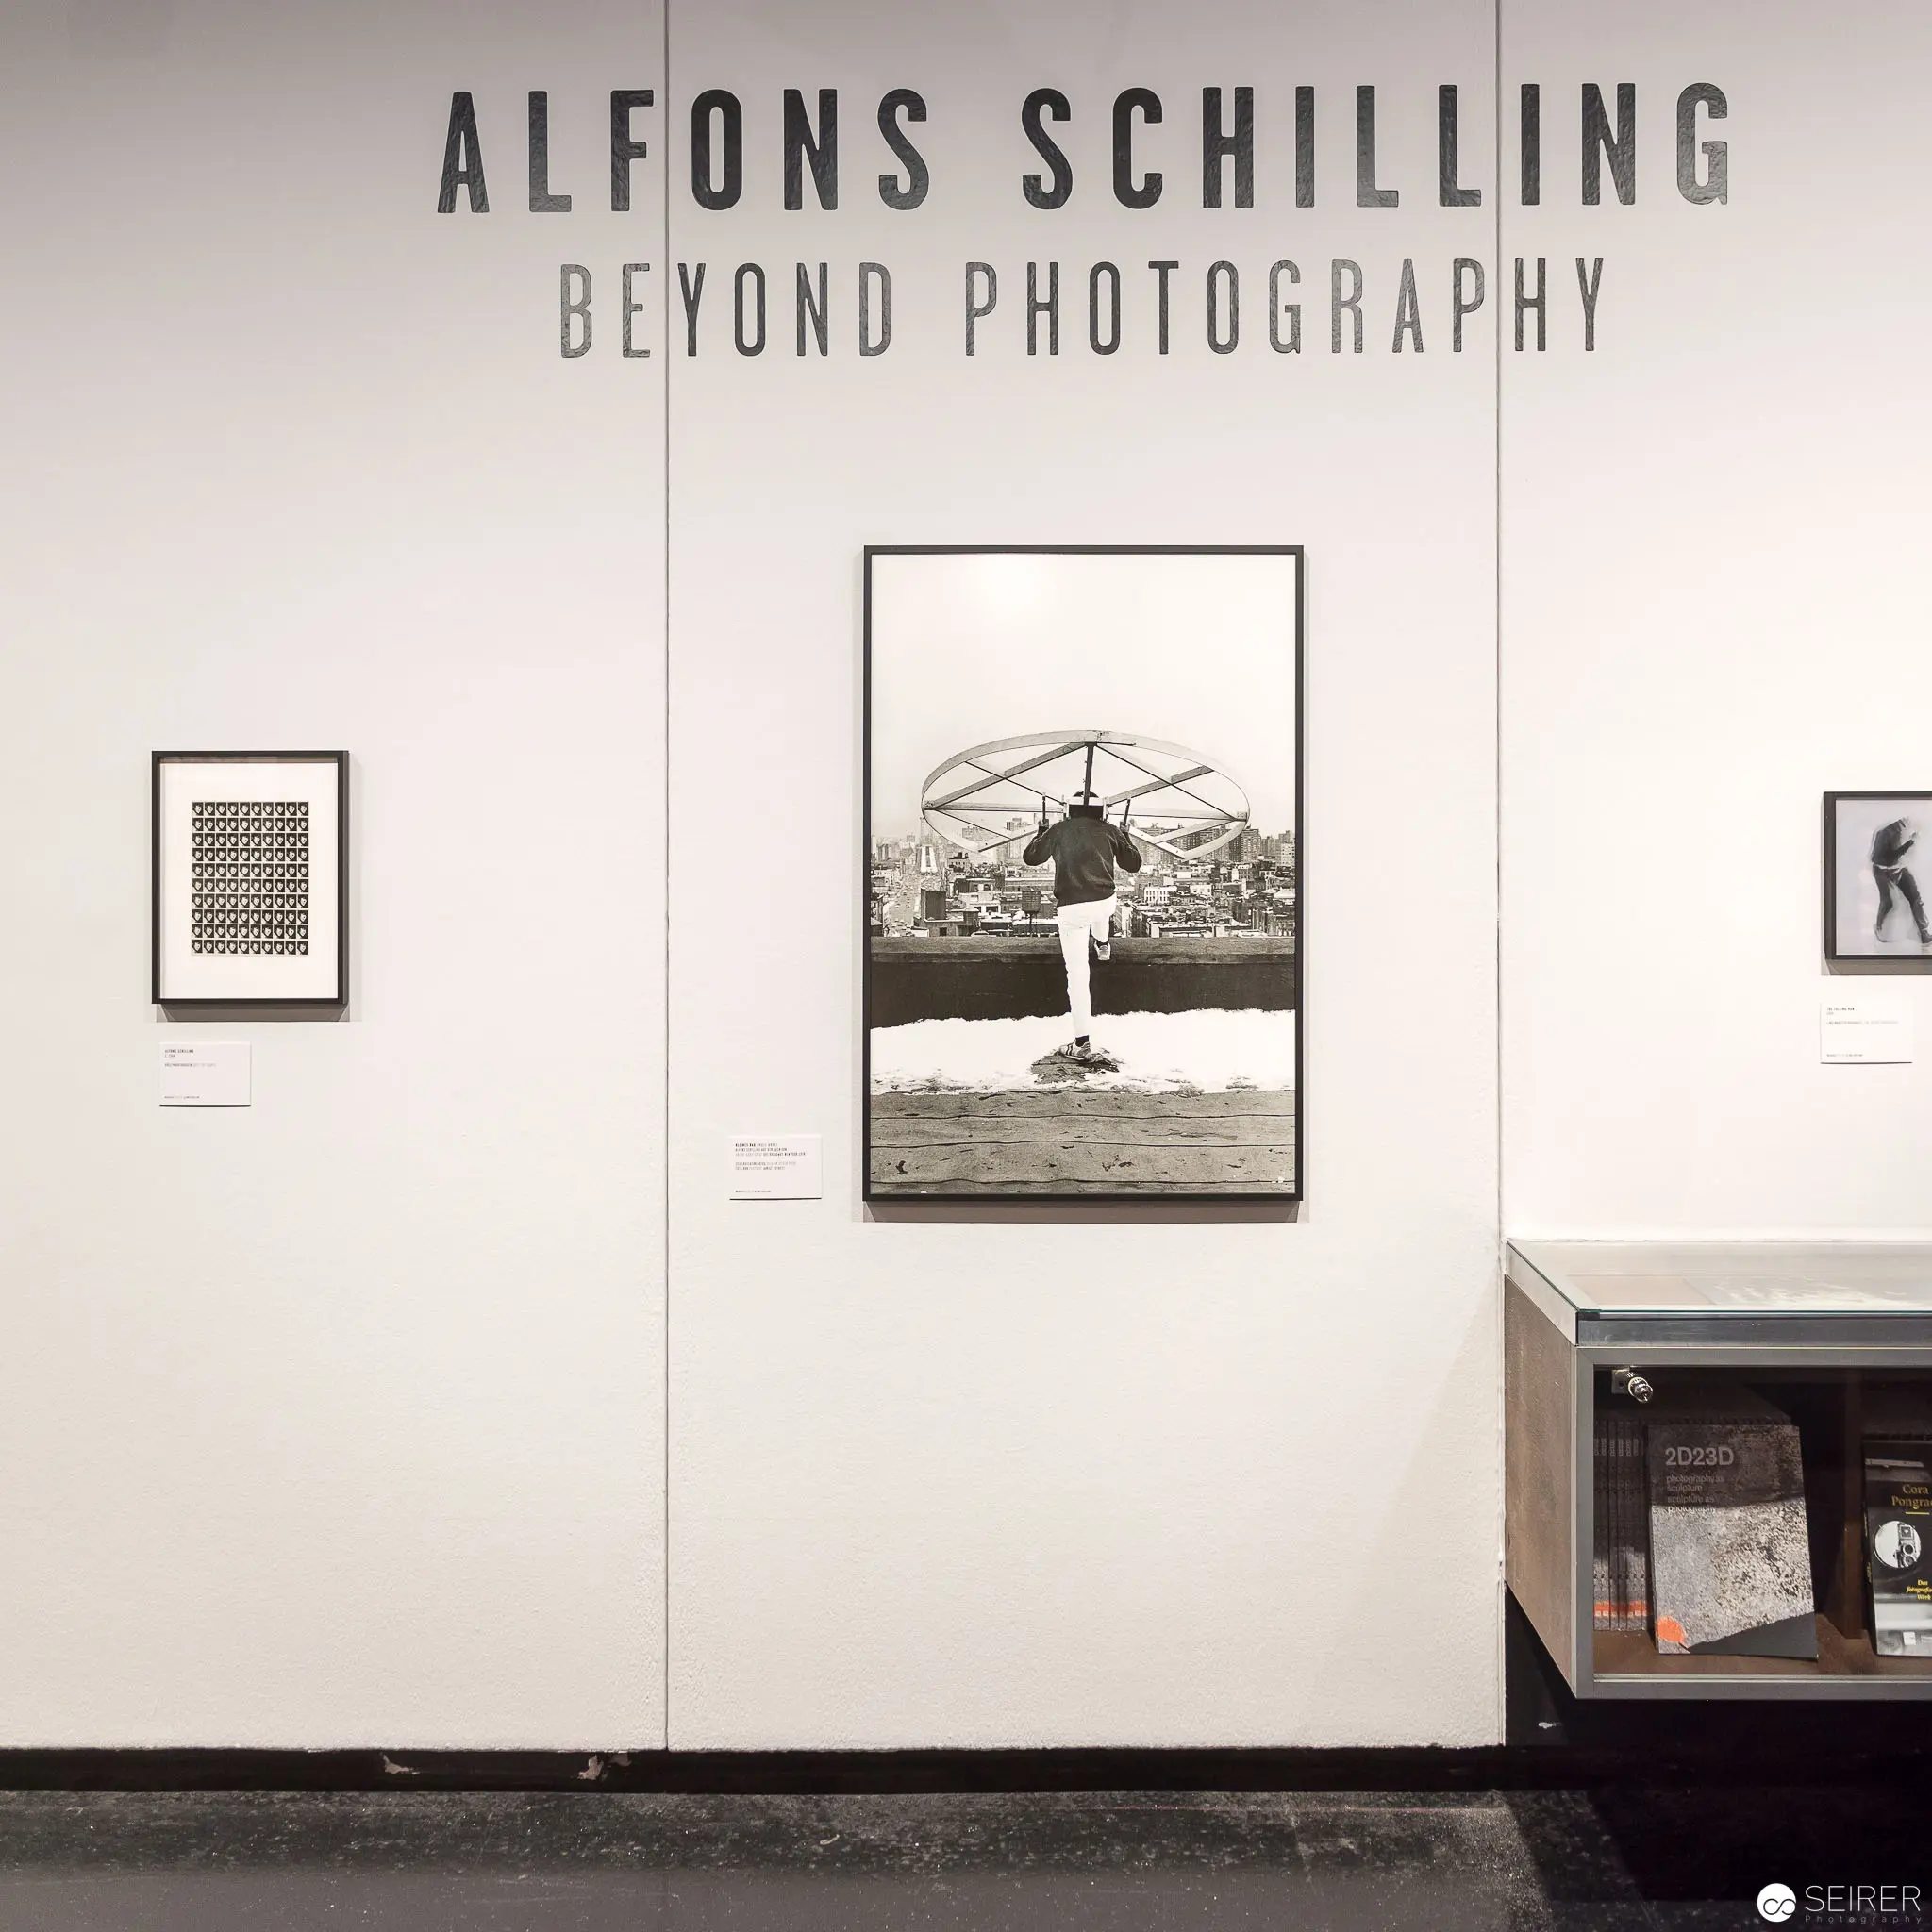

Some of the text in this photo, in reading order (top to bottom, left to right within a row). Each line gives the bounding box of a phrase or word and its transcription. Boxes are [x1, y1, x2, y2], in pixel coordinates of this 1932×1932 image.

[437, 82, 1732, 213] ALFONS SCHILLING
[560, 257, 1605, 358] BEYOND PHOTOGRAPHY
[1665, 1446, 1735, 1466] 2D23D
[1902, 1484, 1929, 1495] Cora
